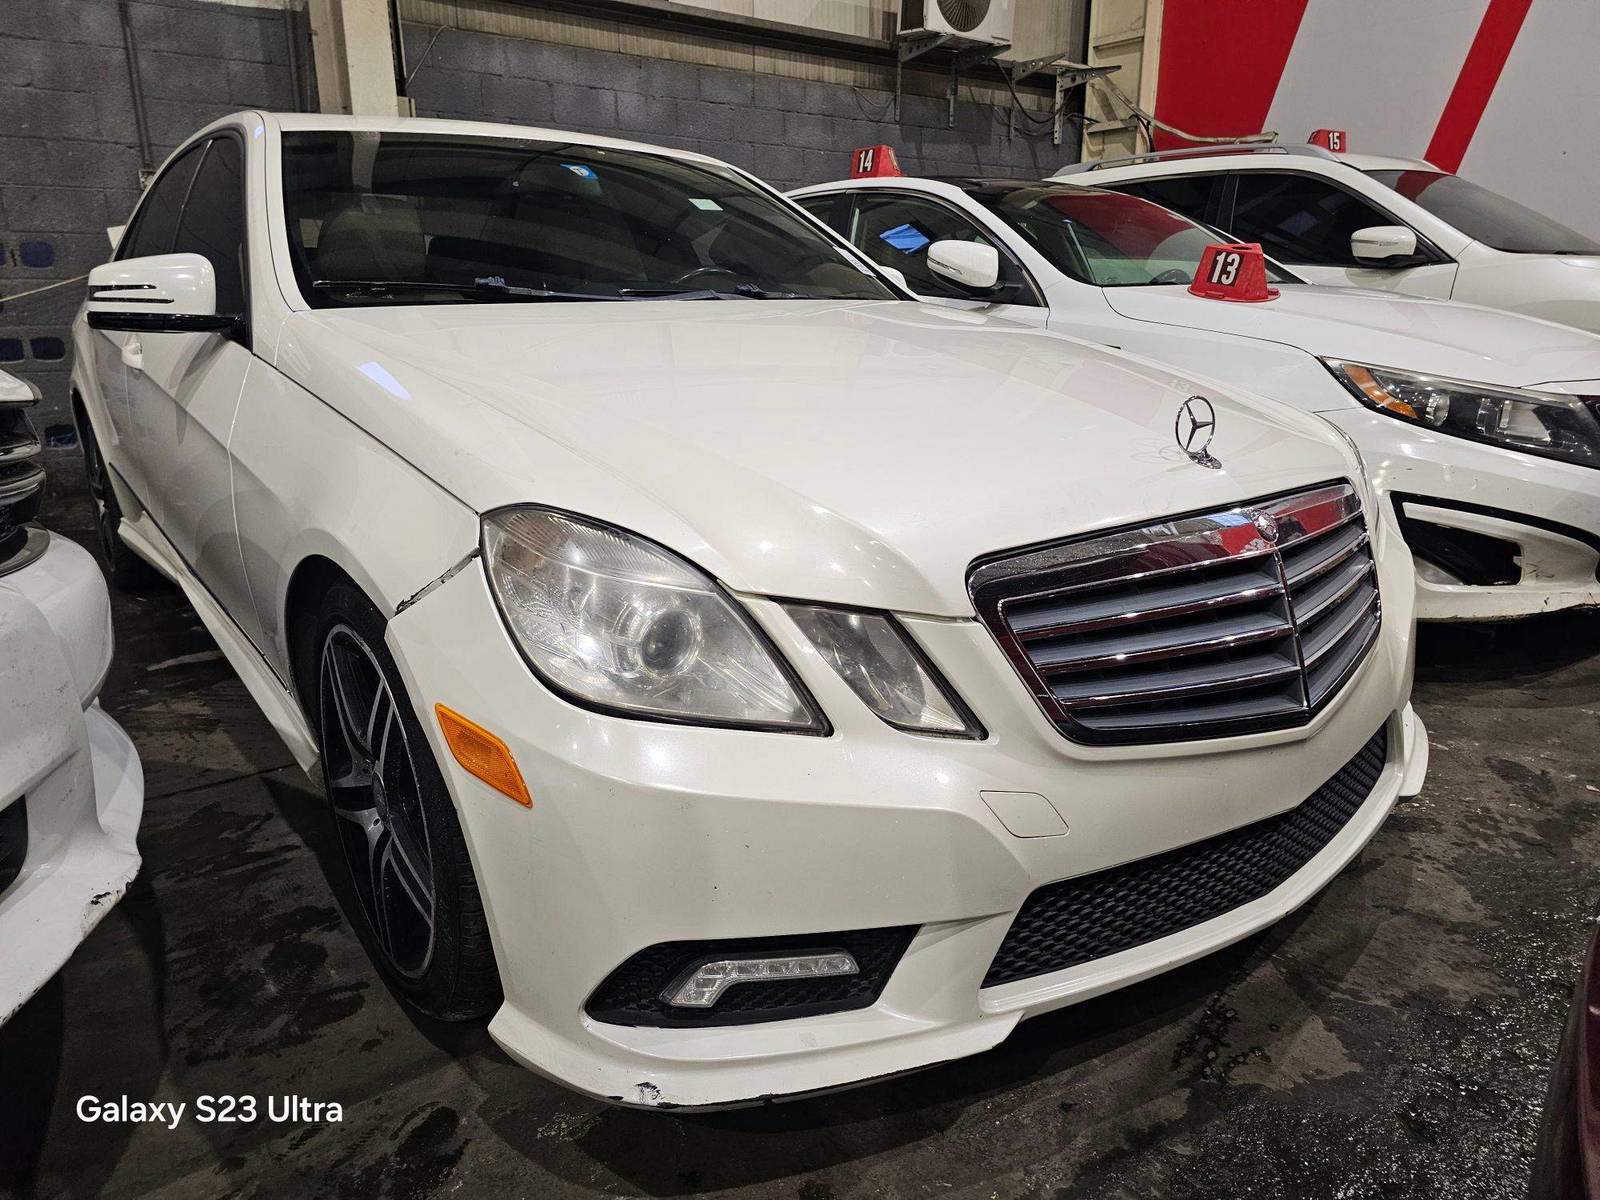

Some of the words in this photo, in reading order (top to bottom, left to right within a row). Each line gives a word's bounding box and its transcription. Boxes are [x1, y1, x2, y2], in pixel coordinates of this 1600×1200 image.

[1329, 132, 1340, 150] 15
[859, 149, 873, 173] 14
[1211, 251, 1240, 285] 13
